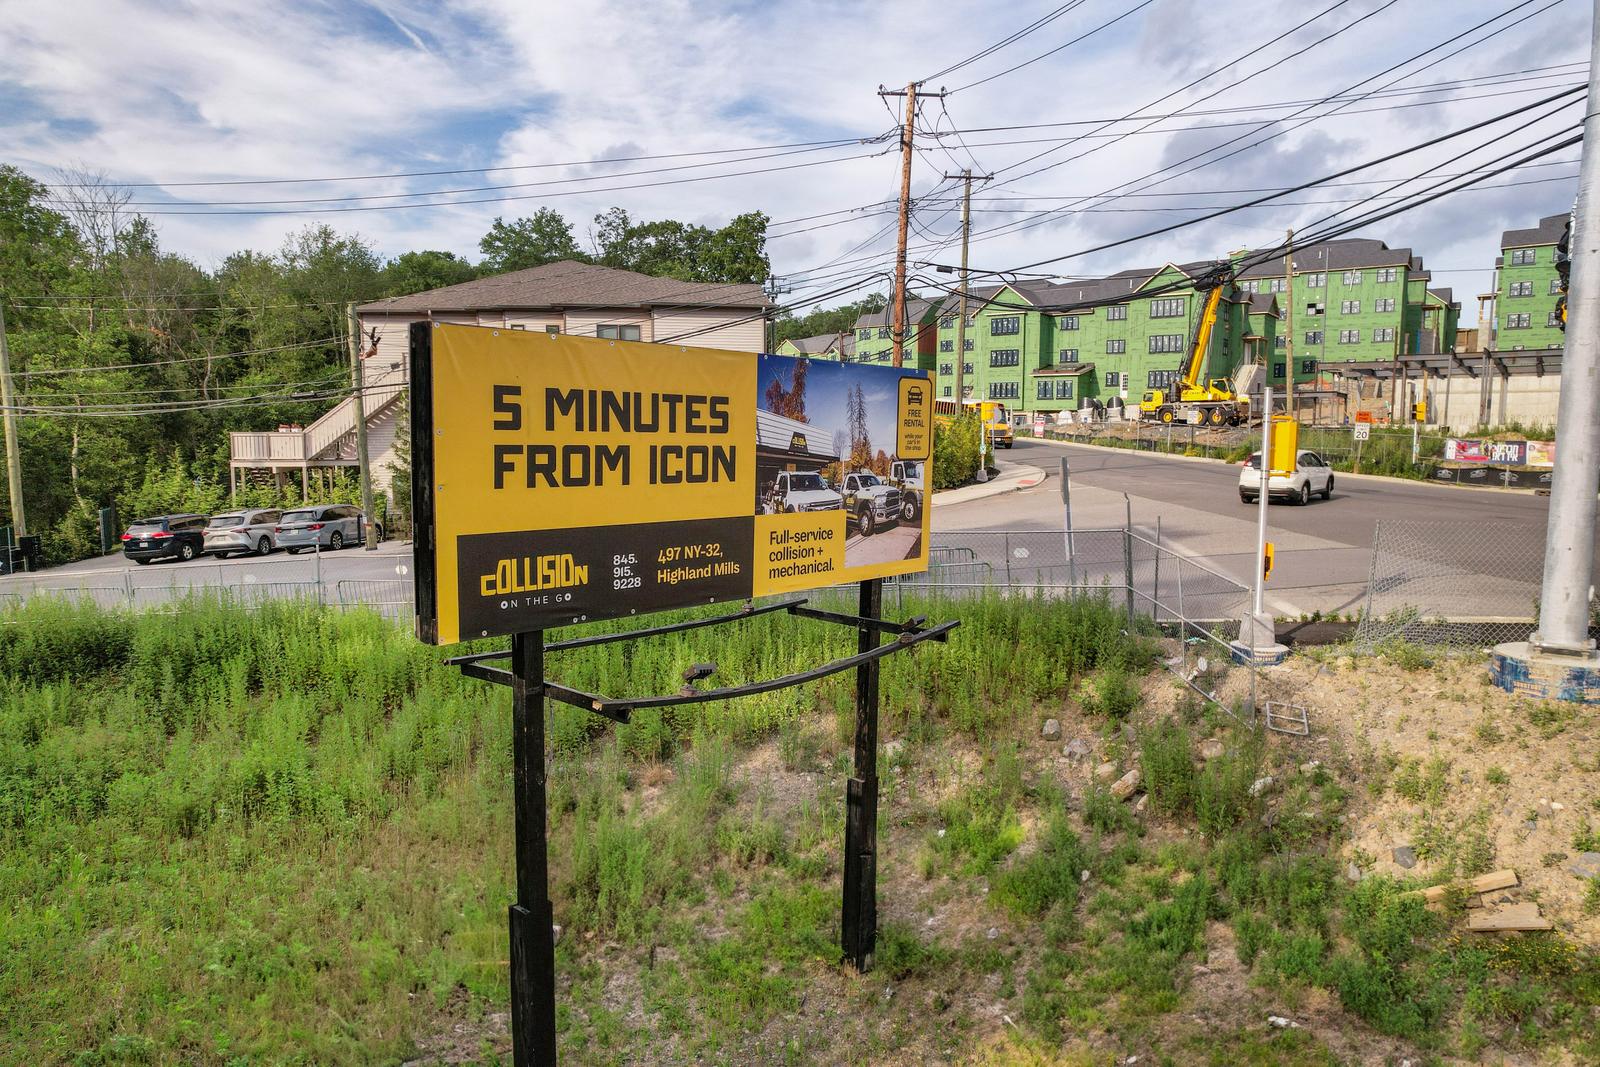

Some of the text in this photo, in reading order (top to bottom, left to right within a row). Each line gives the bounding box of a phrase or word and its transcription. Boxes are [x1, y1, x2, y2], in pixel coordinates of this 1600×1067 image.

[493, 384, 729, 434] 5 MINUTES
[908, 409, 922, 418] FREE
[903, 419, 924, 428] RENTAL
[1356, 431, 1368, 439] 20
[494, 444, 736, 489] FROM ICON
[769, 527, 833, 546] Full-service
[613, 553, 638, 566] 845.
[657, 543, 723, 564] 497 NY-32,
[769, 544, 815, 562] collision
[613, 566, 634, 578] 915.
[657, 561, 740, 585] Highland Mills
[769, 558, 834, 579] mechanical.
[613, 577, 641, 590] 9228
[500, 592, 572, 609] ON THE GO
